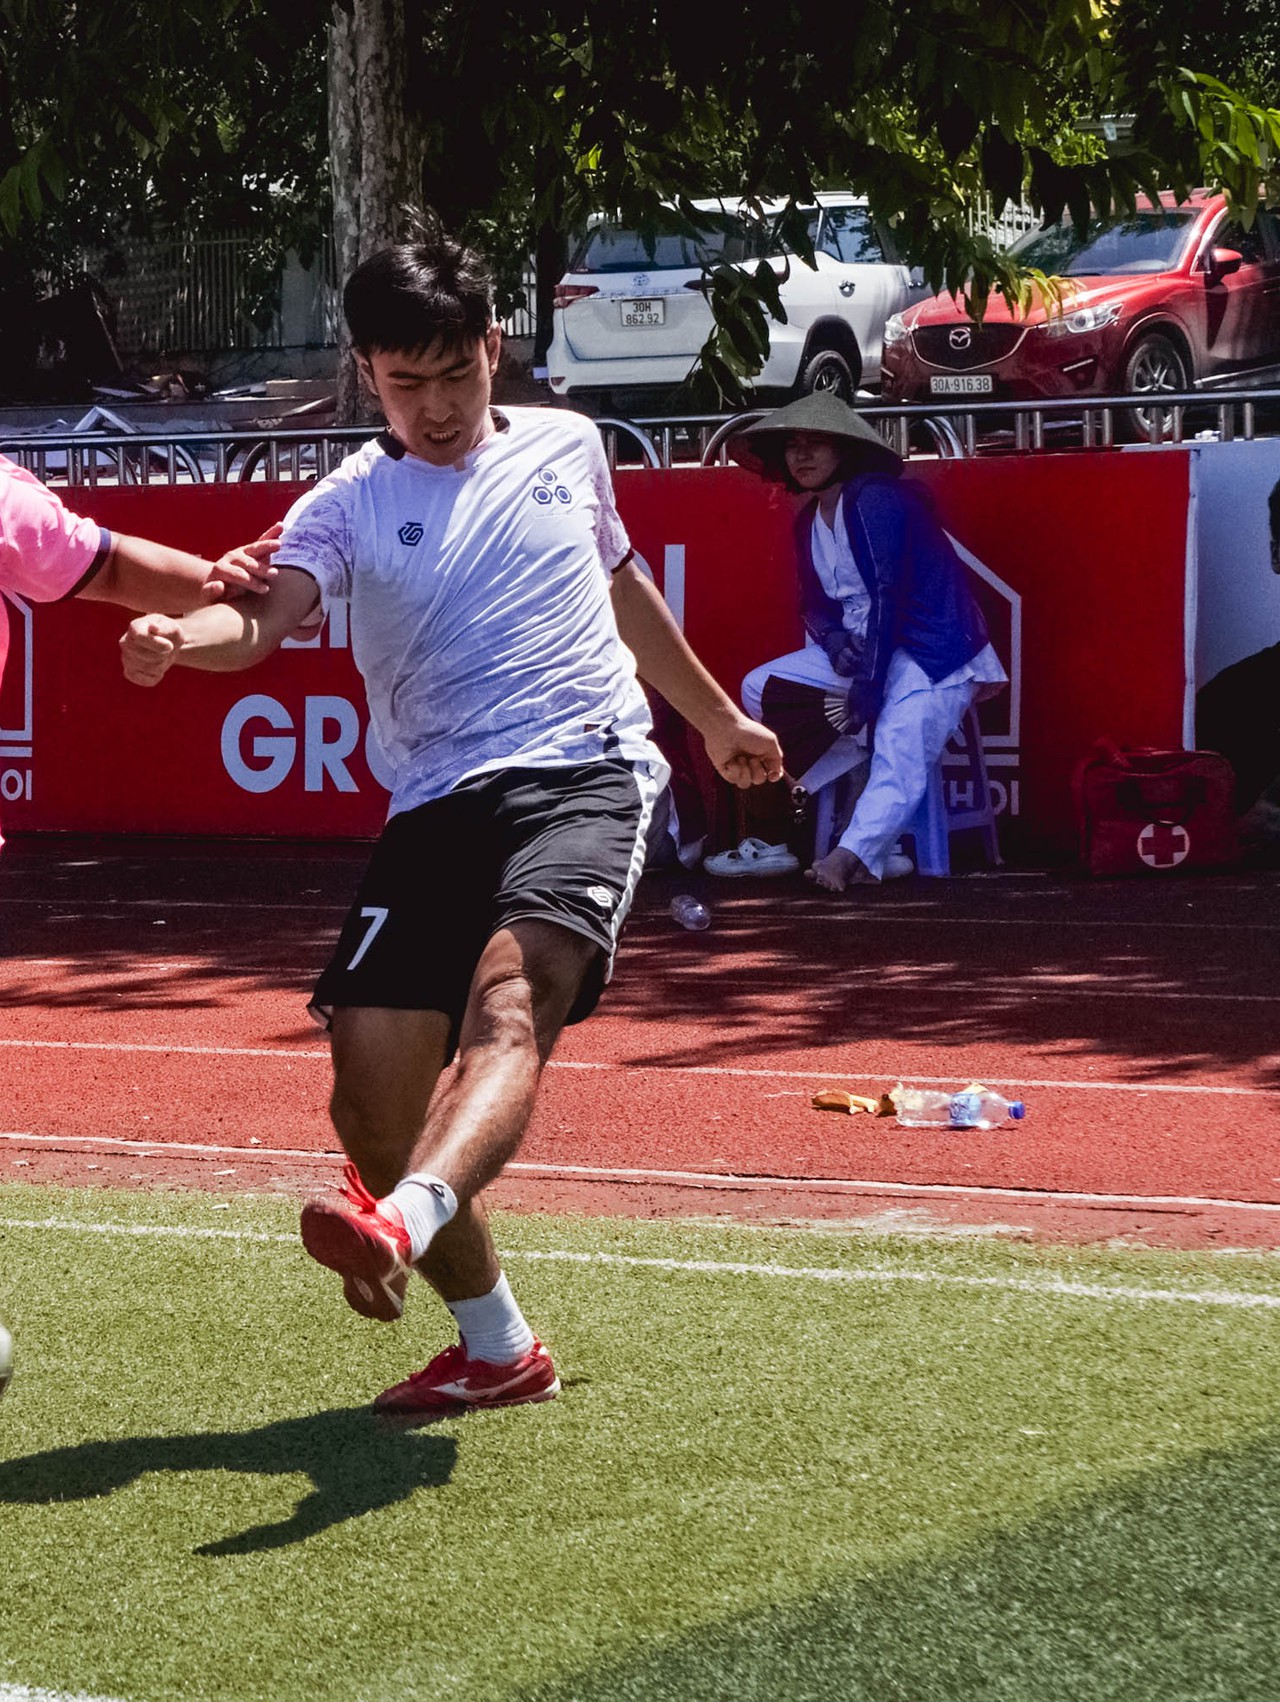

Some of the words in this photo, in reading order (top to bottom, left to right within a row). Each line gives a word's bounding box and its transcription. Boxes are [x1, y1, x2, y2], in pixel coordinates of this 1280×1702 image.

[632, 302, 652, 313] 30H
[626, 313, 660, 325] 862.92
[346, 906, 389, 971] 7
